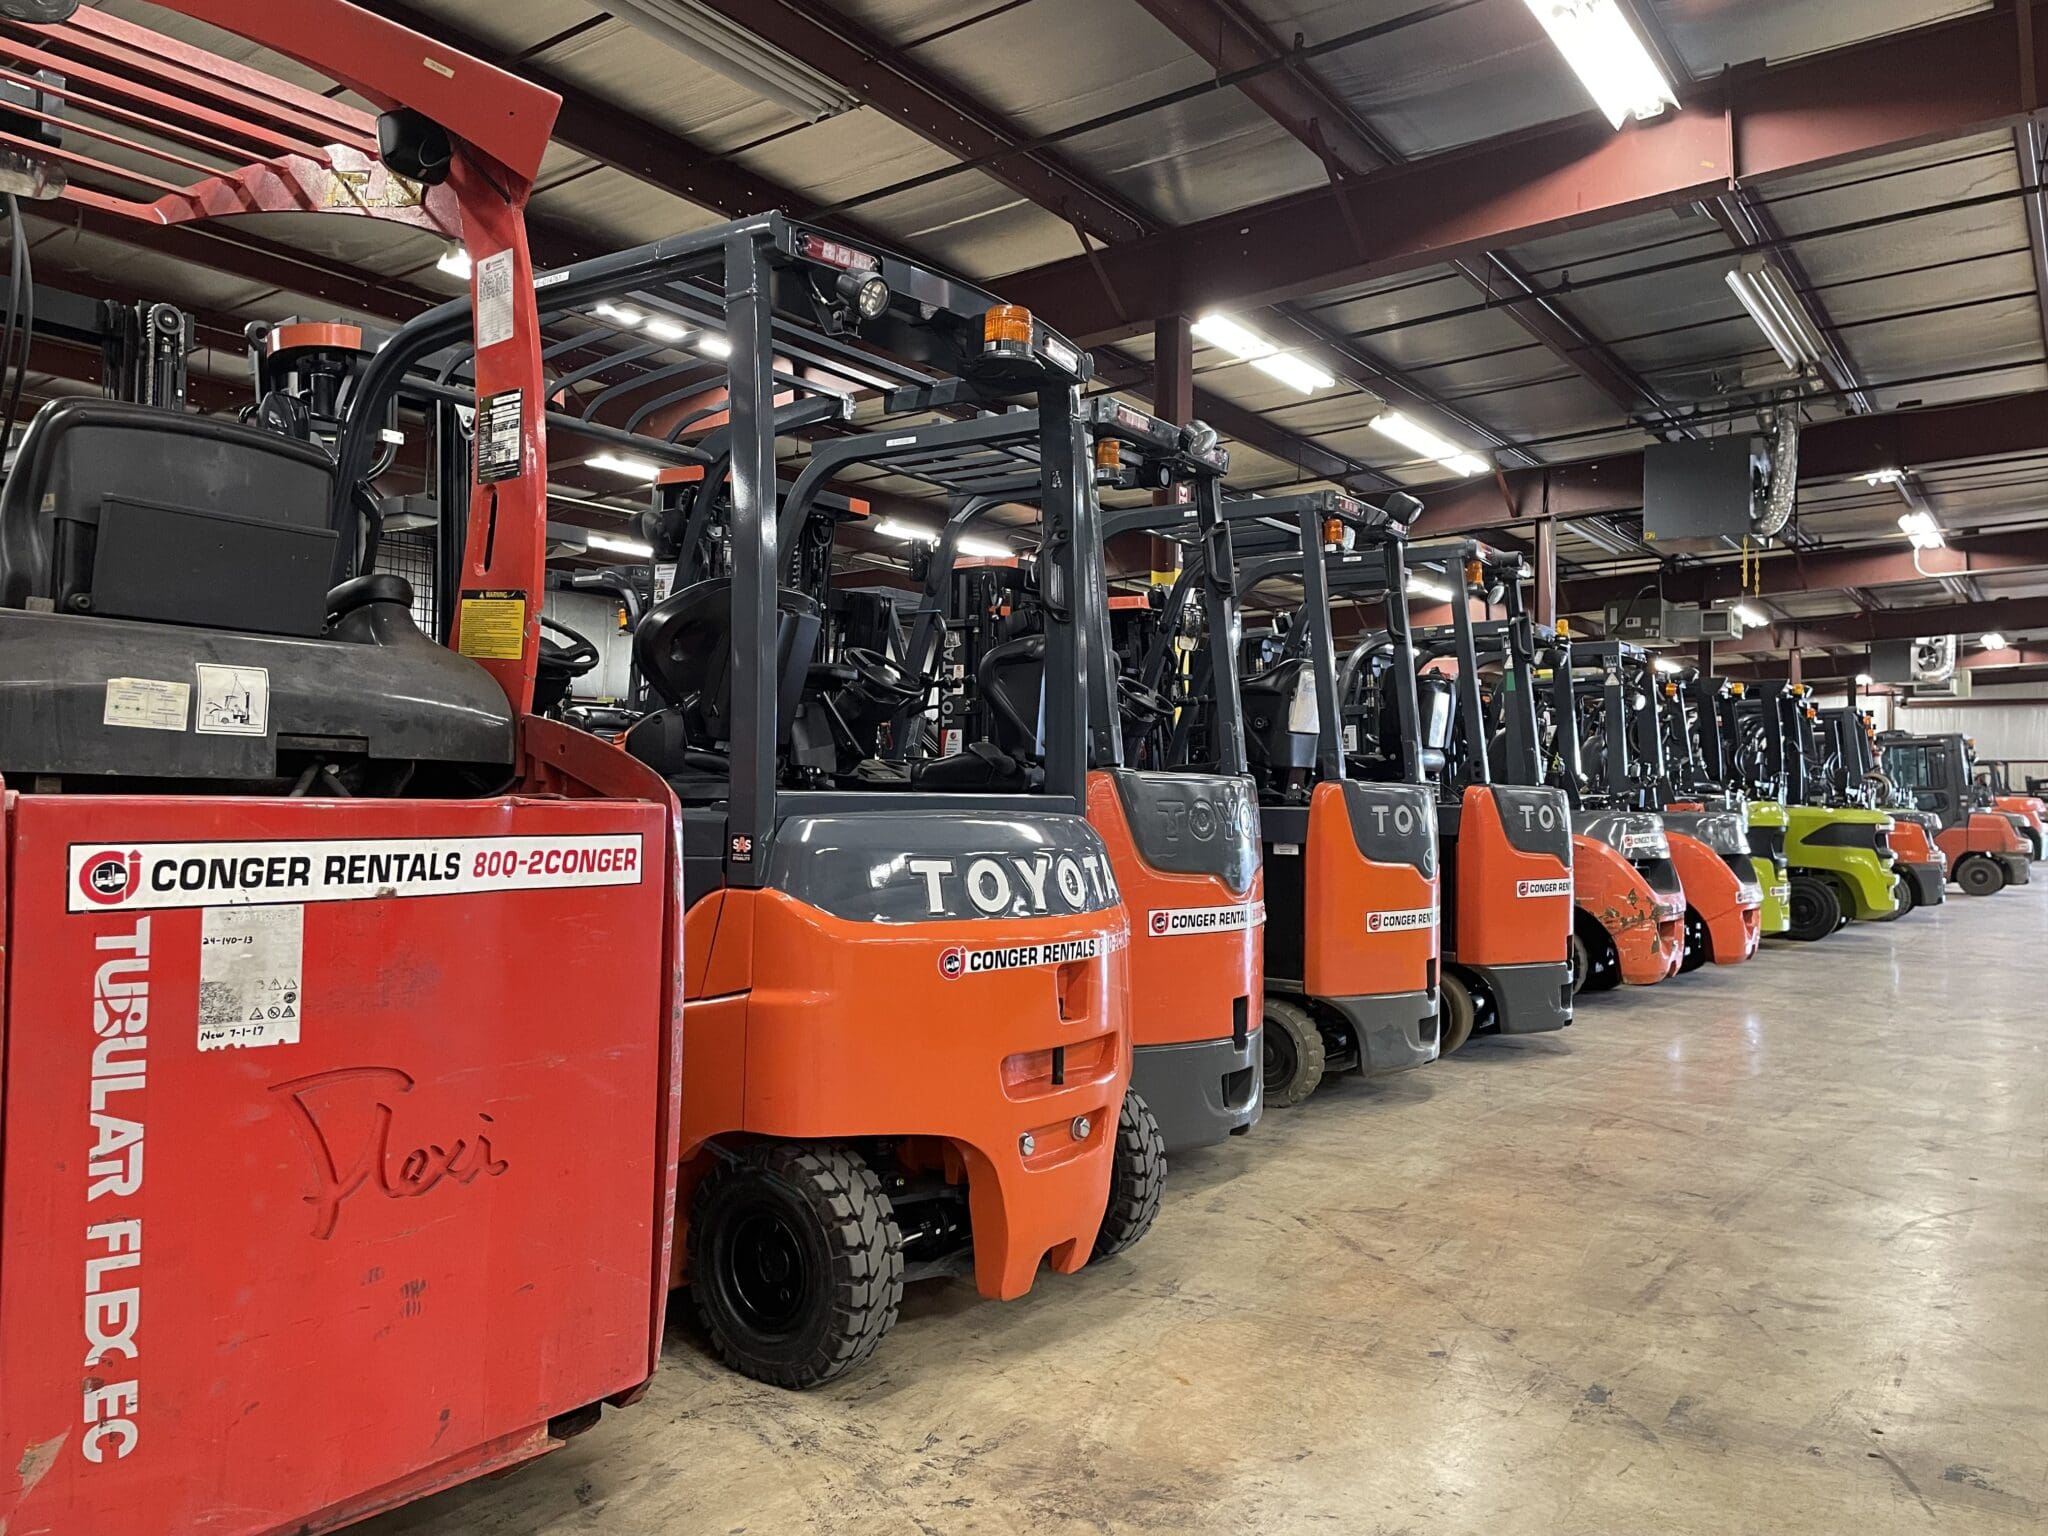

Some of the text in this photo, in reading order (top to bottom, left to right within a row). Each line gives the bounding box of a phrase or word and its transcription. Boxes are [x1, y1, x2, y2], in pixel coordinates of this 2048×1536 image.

[1156, 799, 1258, 841] TOYO
[1371, 804, 1430, 836] TOY
[733, 836, 751, 852] SAS
[151, 848, 637, 891] CONGER RENTALS 800-2CONGER
[909, 854, 1119, 913] TOYOTA
[1530, 882, 1557, 893] CONGER
[1172, 913, 1216, 929] CONGER
[1219, 909, 1249, 926] RENTAL
[1383, 914, 1416, 927] CONGER
[203, 935, 253, 945] 24-140-13
[970, 946, 1038, 971] CONGER
[1043, 939, 1095, 962] RENTALS
[201, 1026, 264, 1041] New 7-1-17
[82, 916, 150, 1463] TUBULAR FLEX EC
